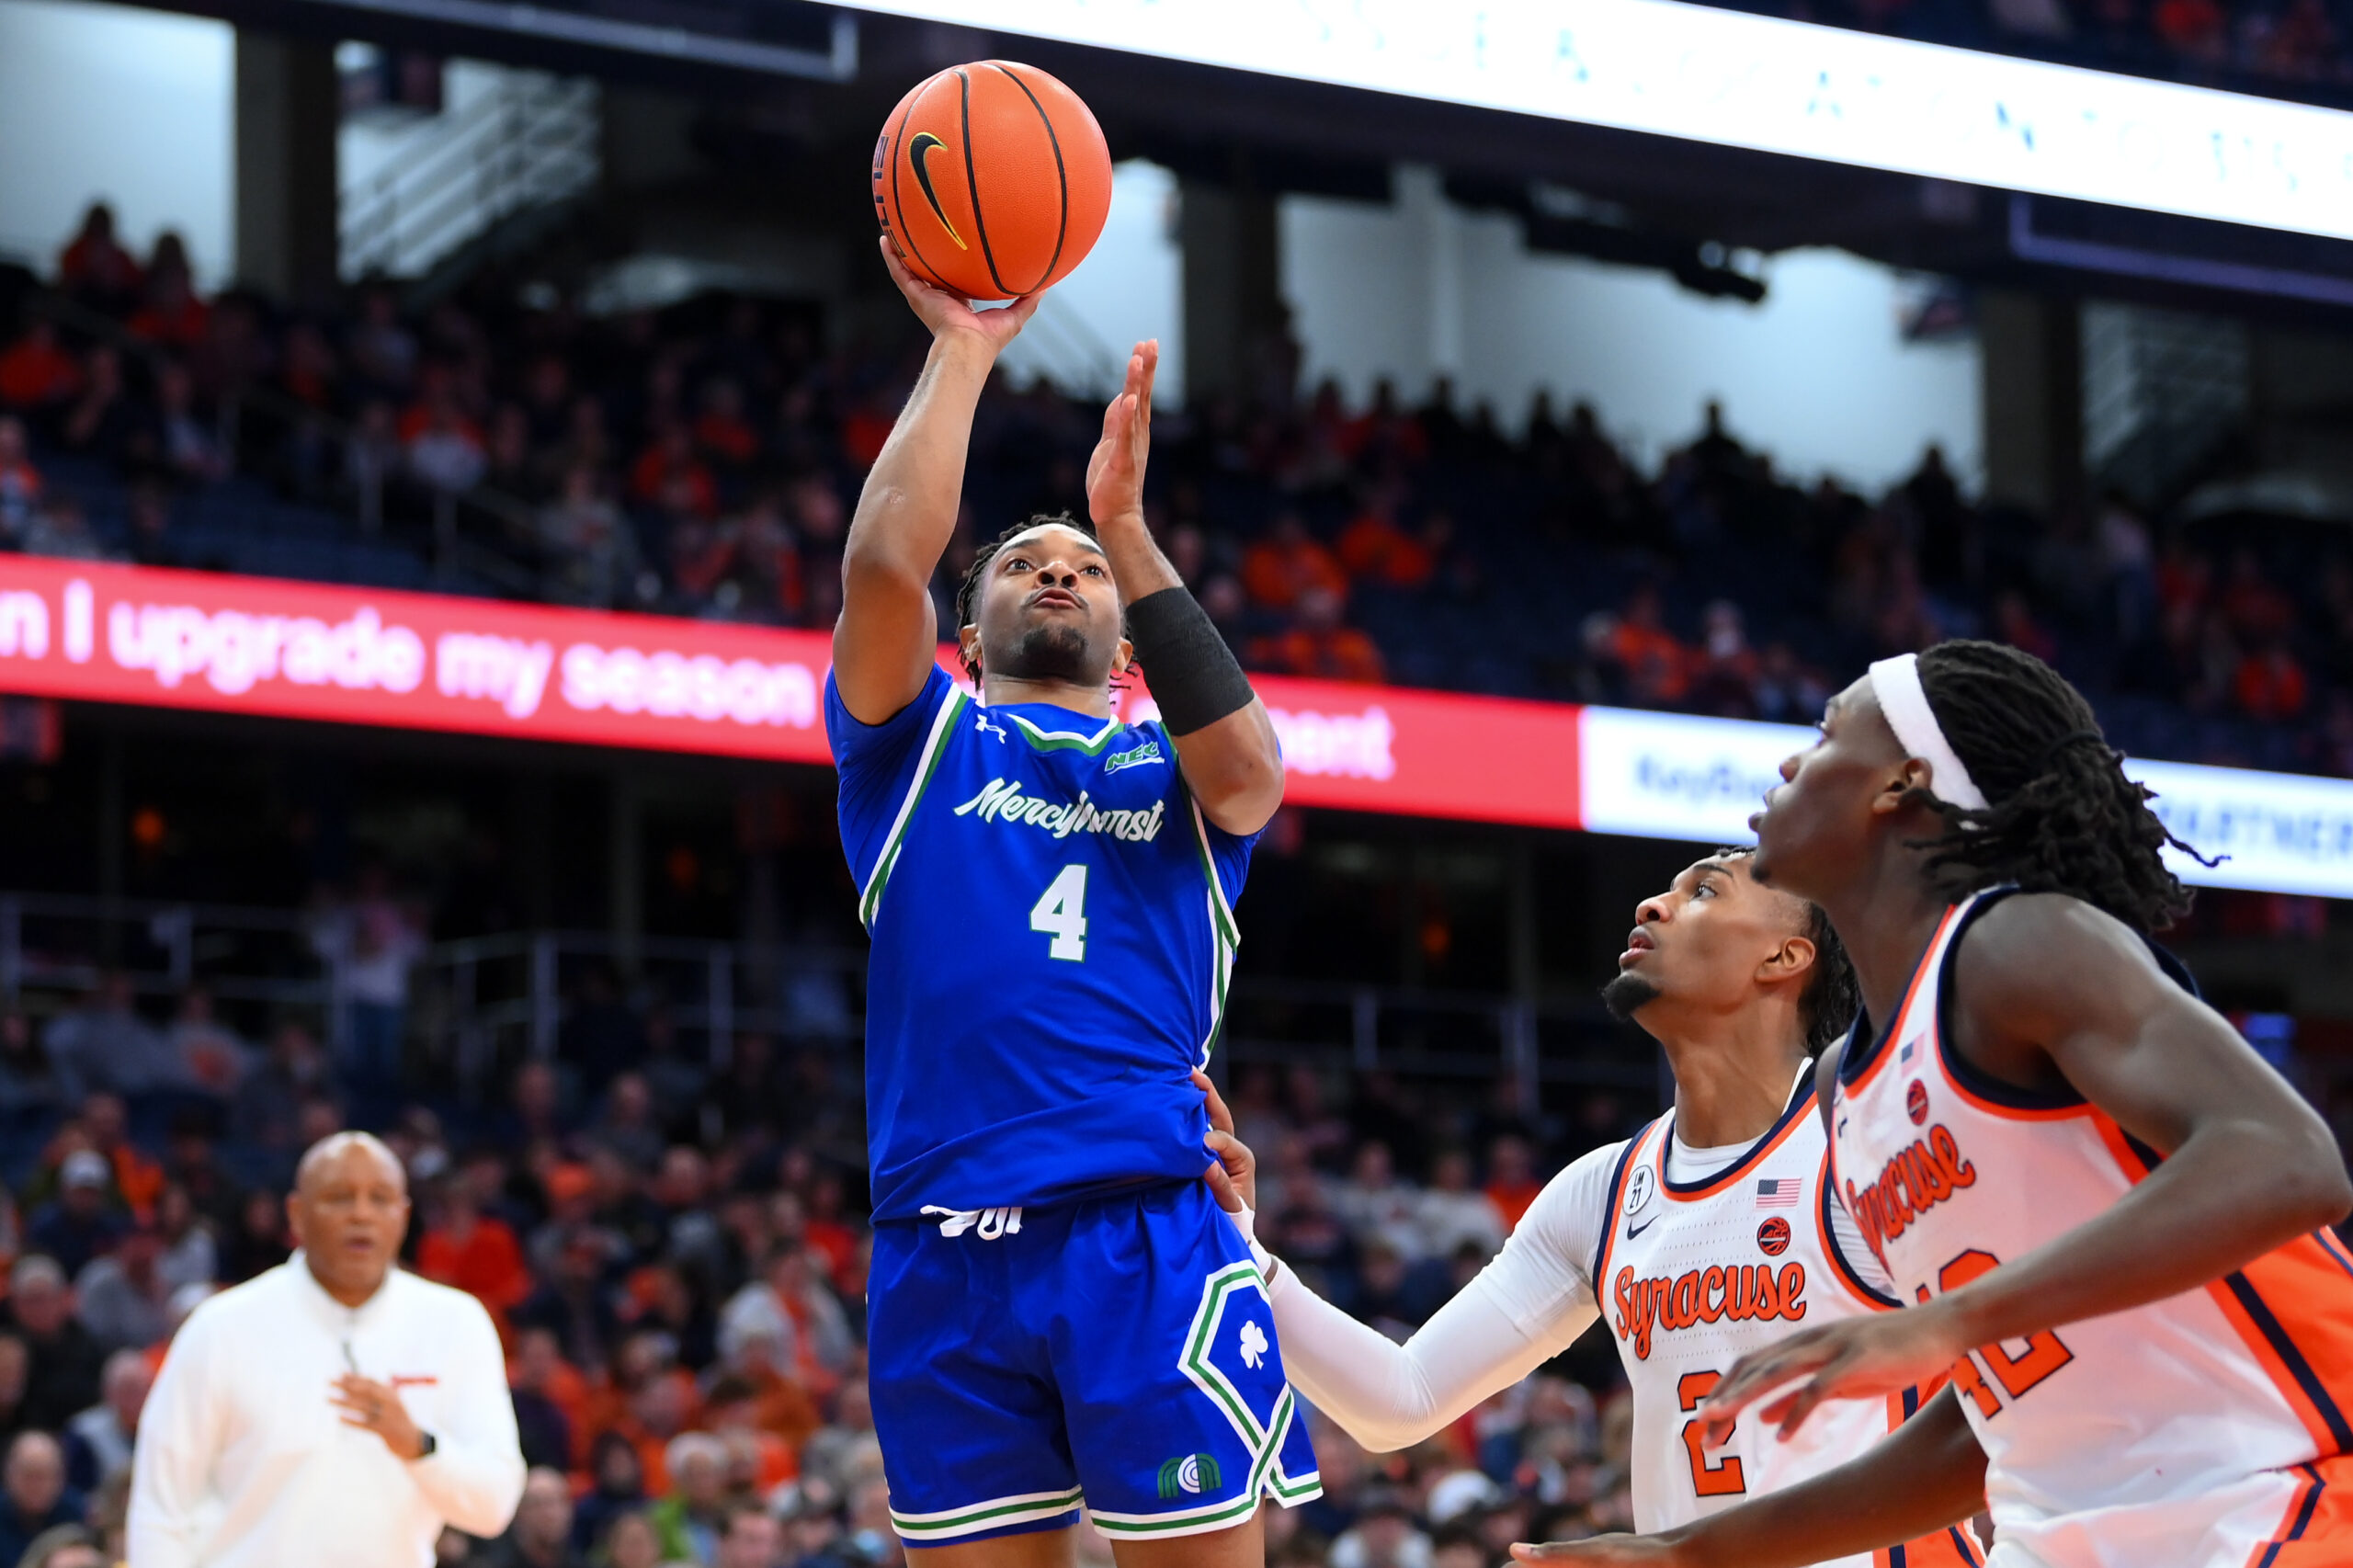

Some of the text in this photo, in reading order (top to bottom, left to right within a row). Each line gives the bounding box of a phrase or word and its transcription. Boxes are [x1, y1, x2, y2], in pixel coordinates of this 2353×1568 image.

[63, 578, 95, 665] I
[108, 601, 426, 696] upgrade
[435, 631, 554, 719] my
[561, 642, 817, 729] season
[1104, 741, 1160, 772] NEC
[953, 777, 1165, 842] Mercyhurst
[1029, 863, 1088, 963] 4
[1629, 1187, 1643, 1210] 21
[1614, 1262, 1806, 1360] Syracuse
